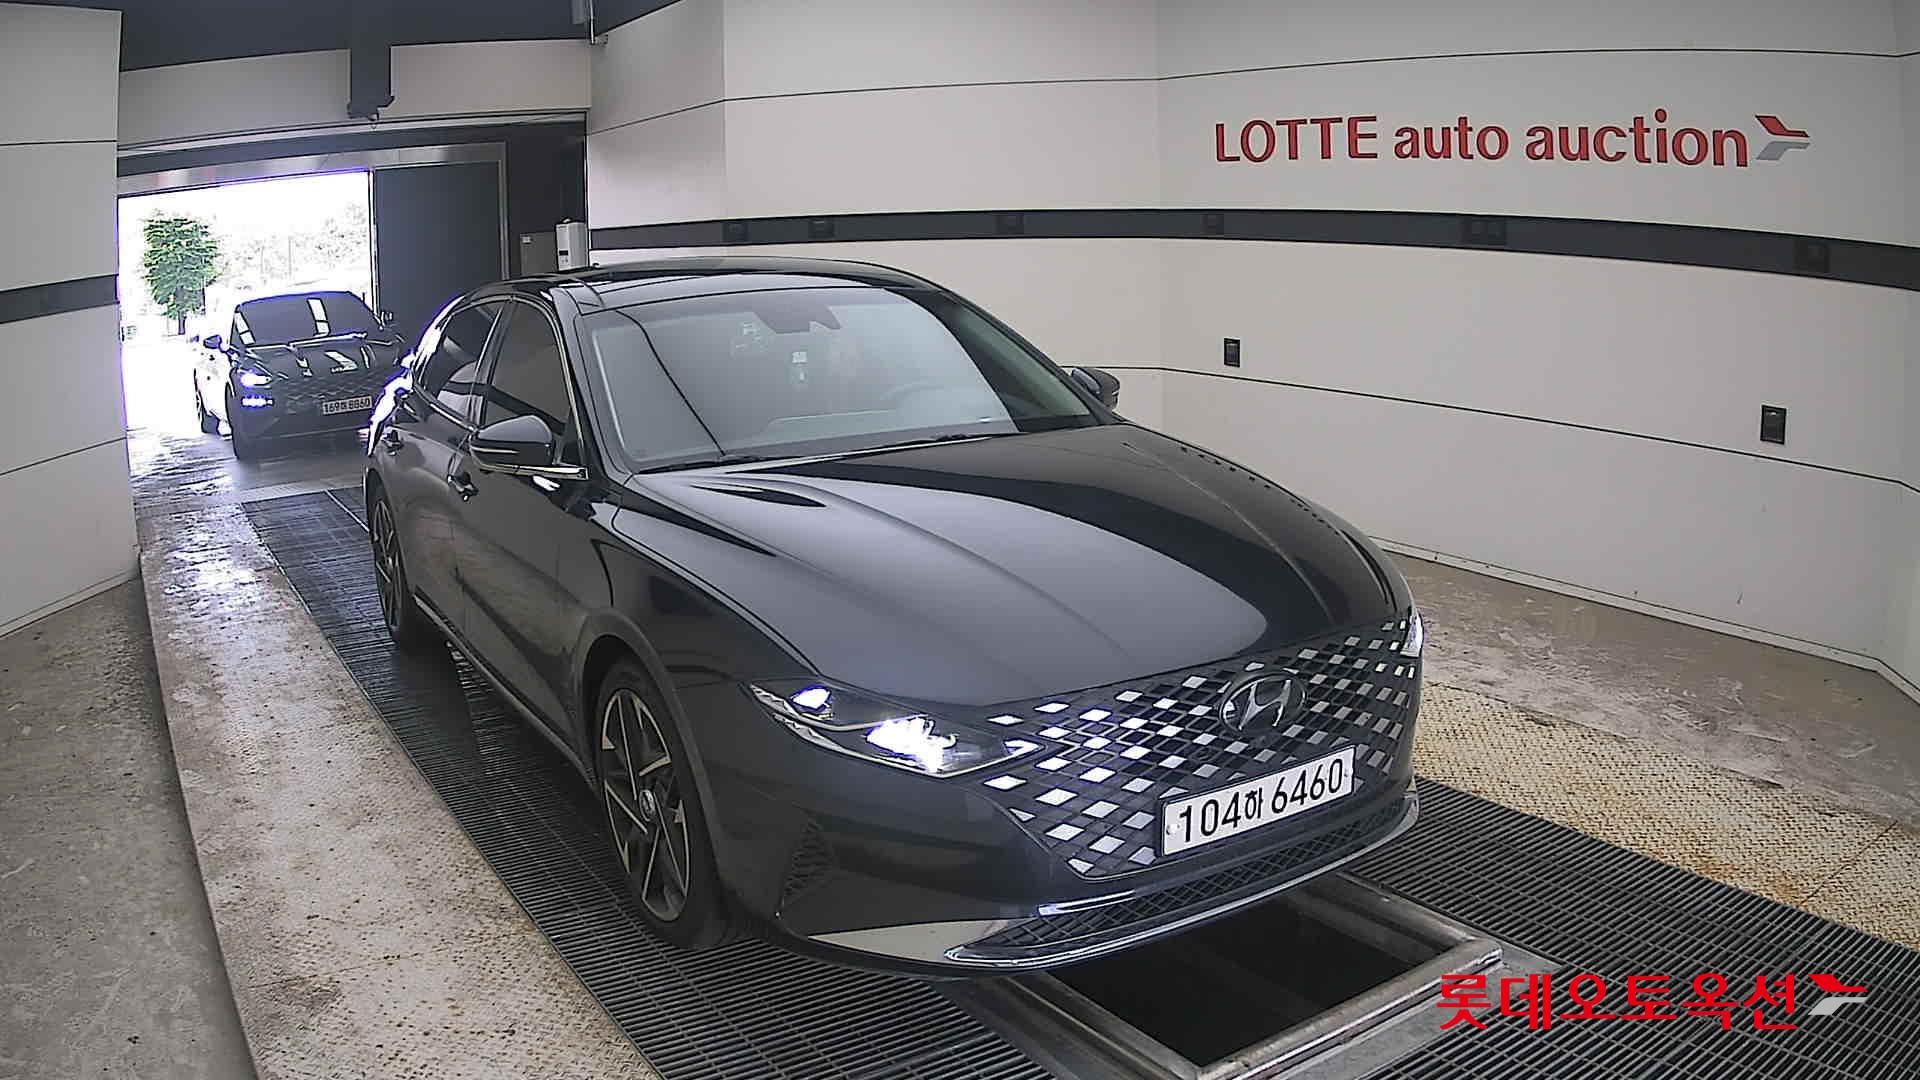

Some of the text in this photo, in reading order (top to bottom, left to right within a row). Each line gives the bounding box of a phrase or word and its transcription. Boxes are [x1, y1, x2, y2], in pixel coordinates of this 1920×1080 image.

[1215, 108, 1748, 167] LOTTE auto auction
[1179, 758, 1343, 842] 104하 6460
